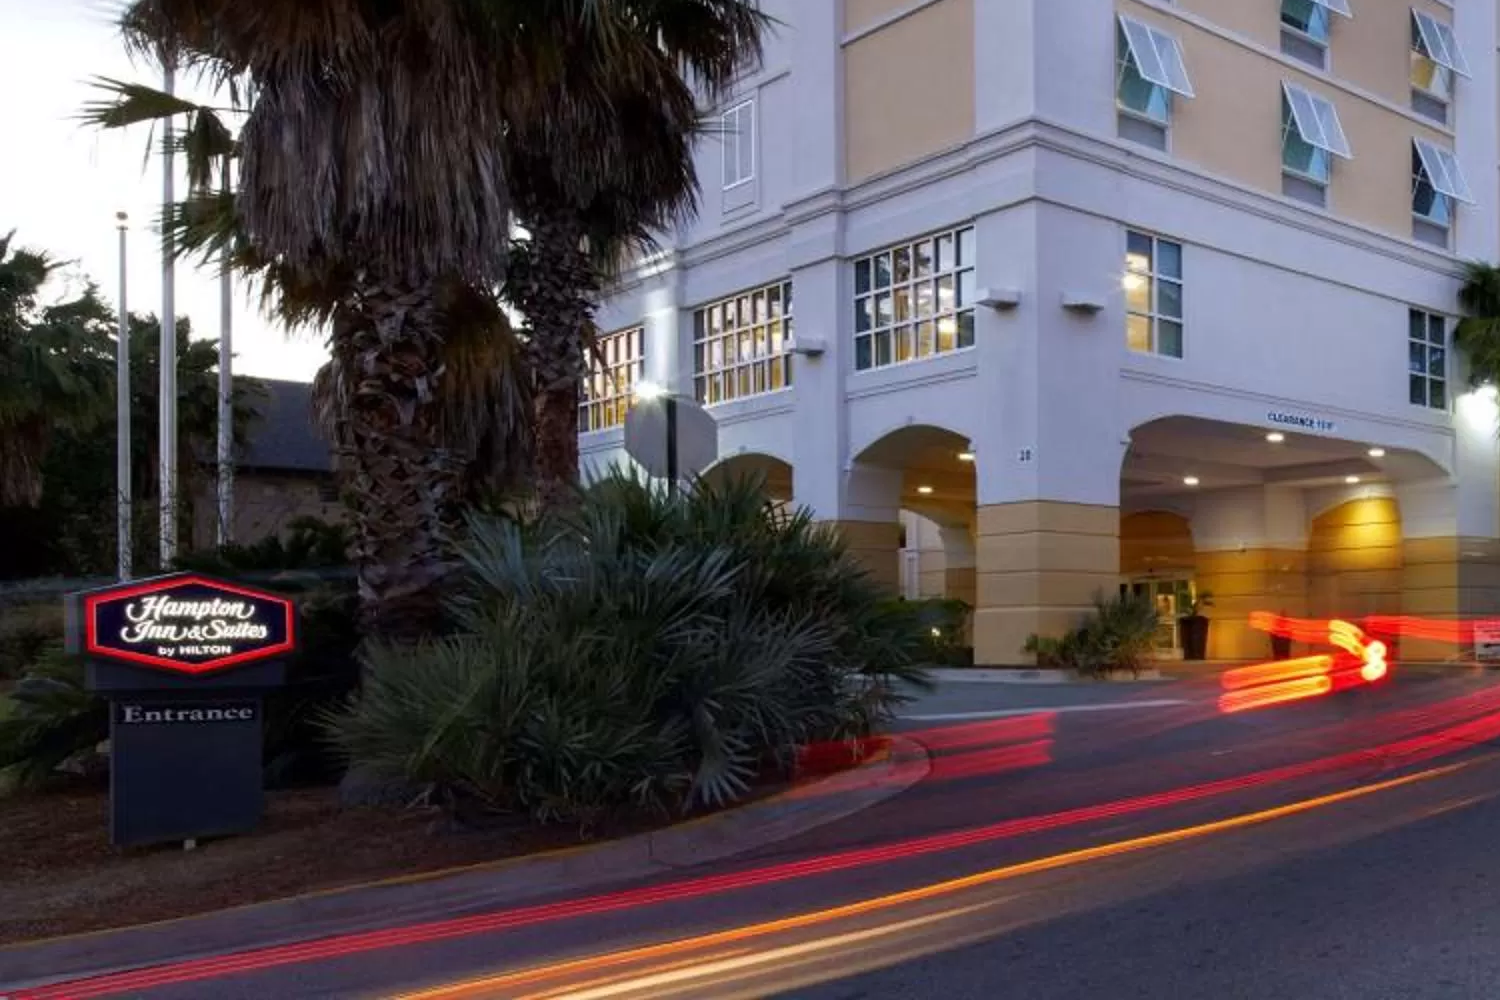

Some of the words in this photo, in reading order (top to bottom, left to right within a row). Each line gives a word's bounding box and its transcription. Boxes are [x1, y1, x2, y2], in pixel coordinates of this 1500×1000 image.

[125, 595, 256, 622] Hampton
[120, 618, 189, 643] Inn
[188, 627, 203, 641] &
[201, 618, 269, 640] Suites
[157, 645, 175, 657] by
[179, 645, 232, 655] HILTON
[123, 704, 254, 723] Entrance
